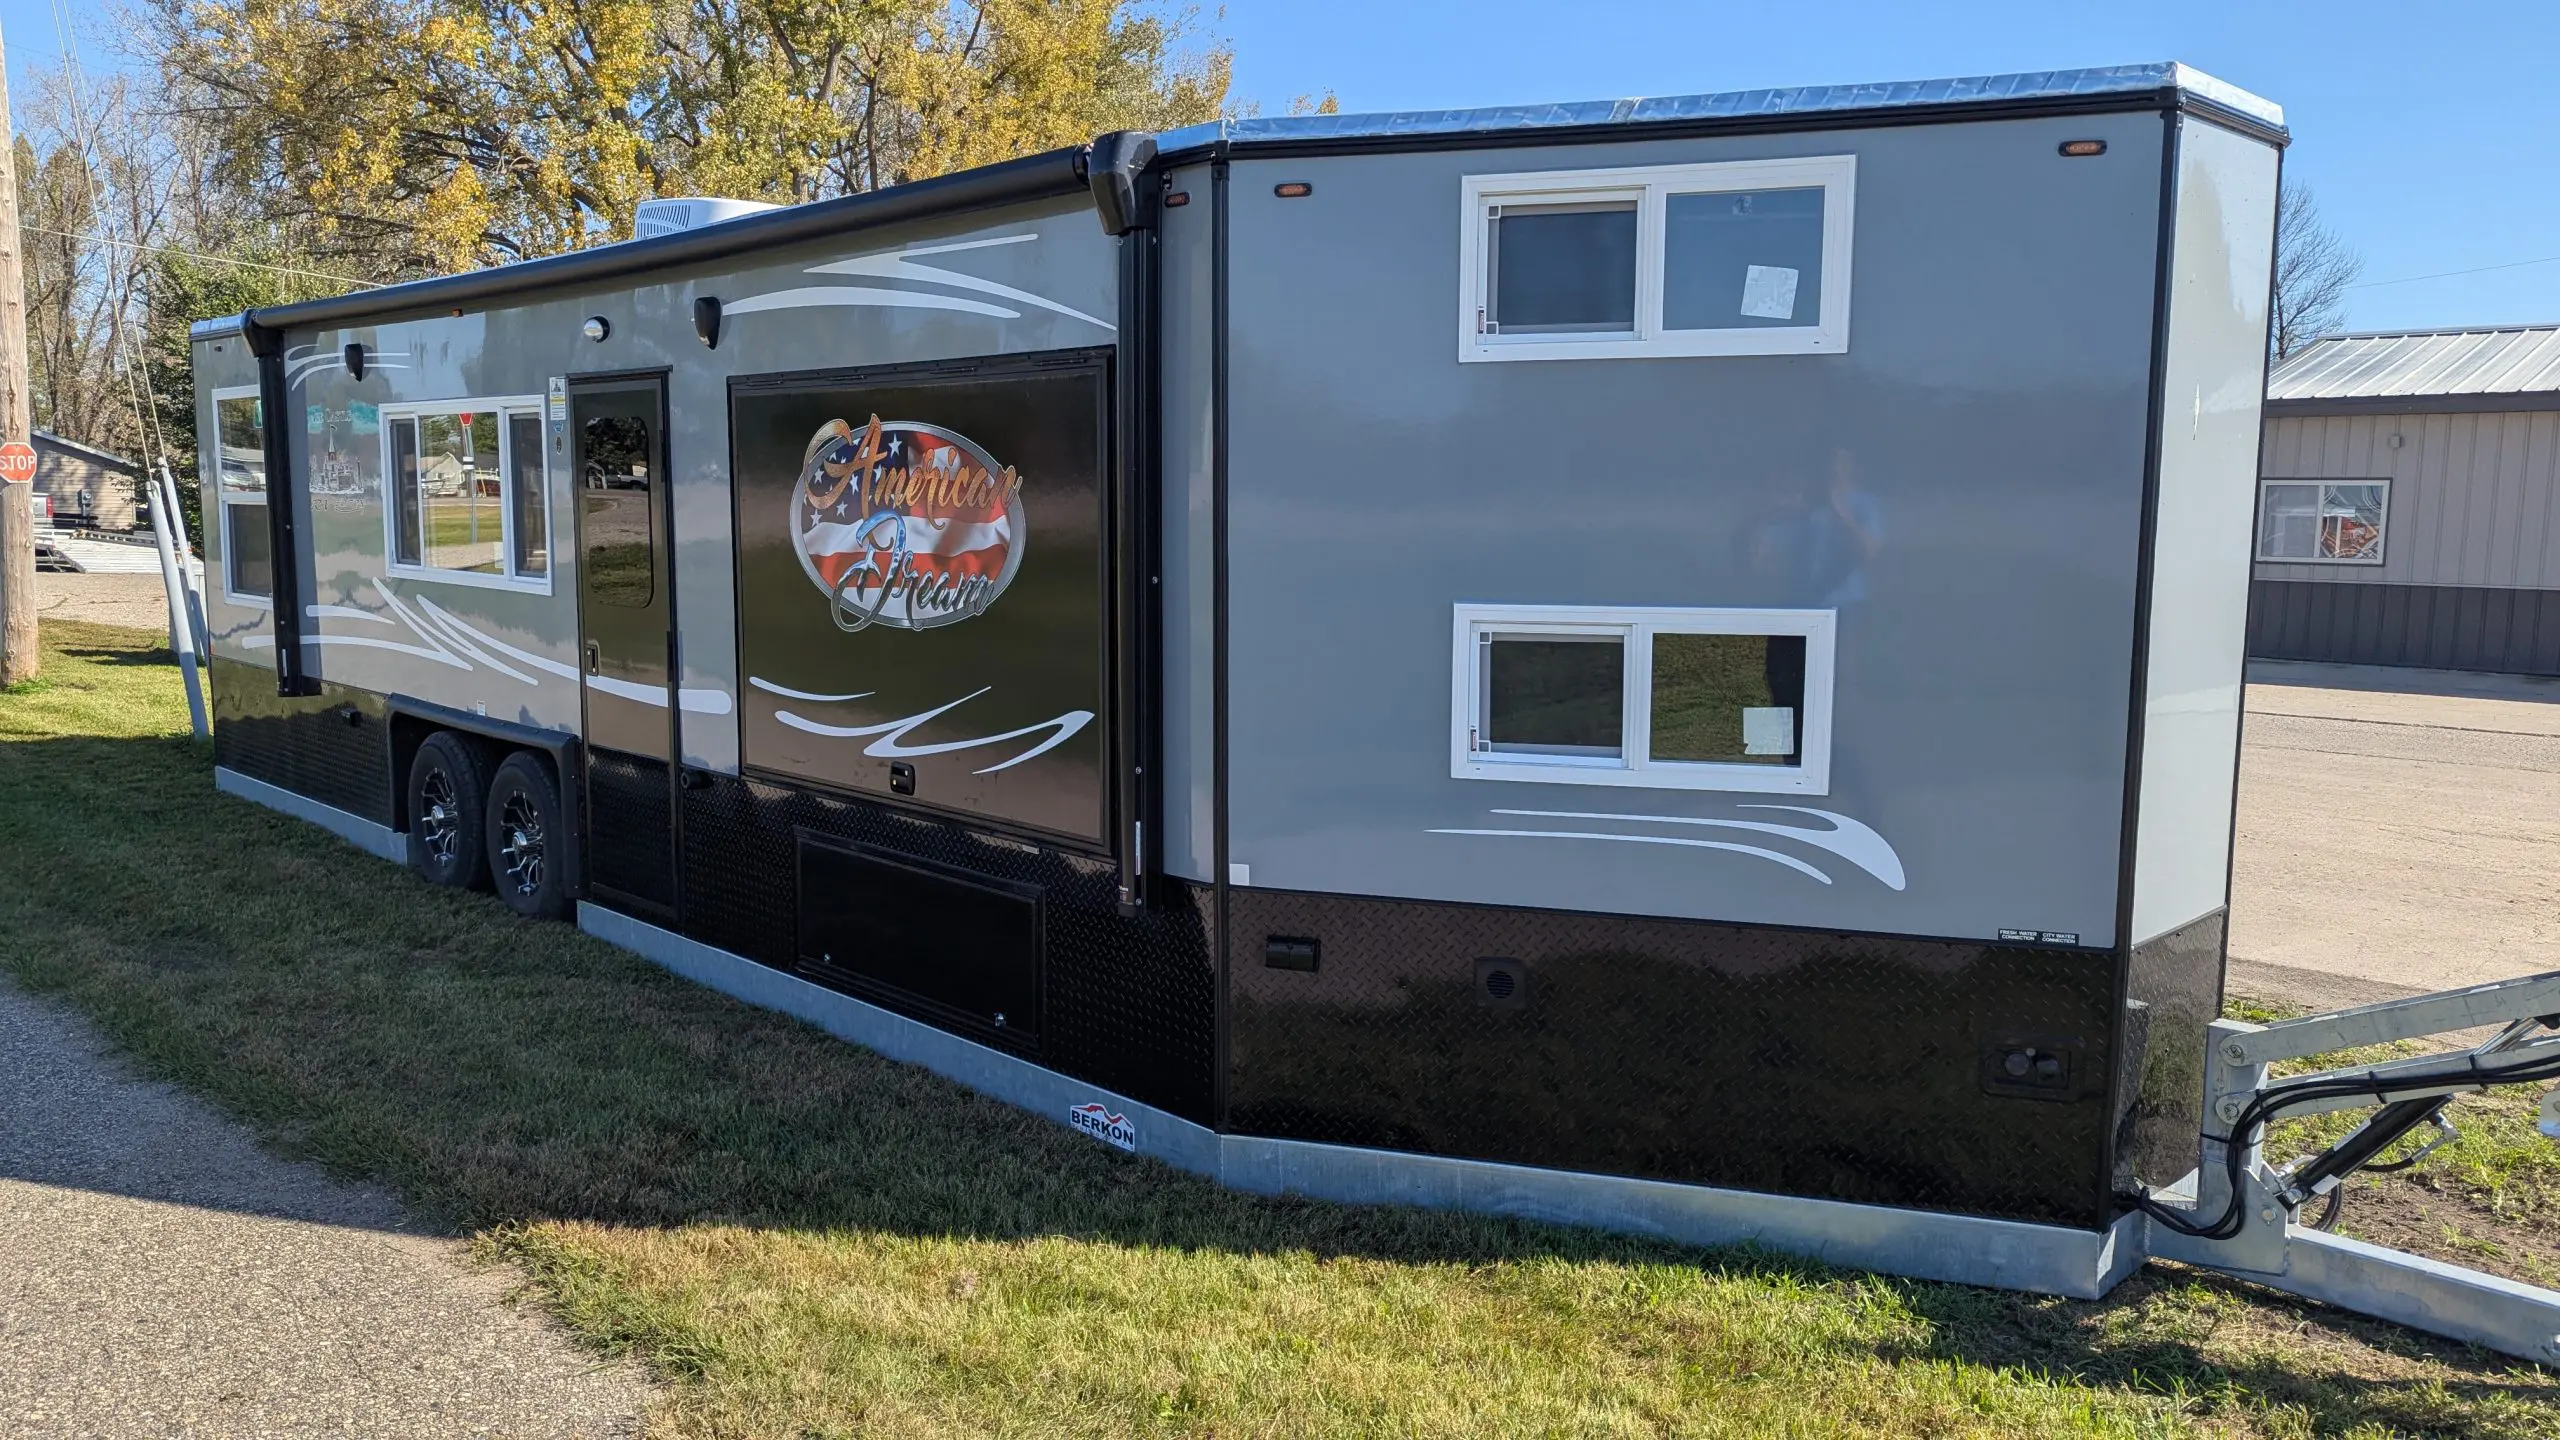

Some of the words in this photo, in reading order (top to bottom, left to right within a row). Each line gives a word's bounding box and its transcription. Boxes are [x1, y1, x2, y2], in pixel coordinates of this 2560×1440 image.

[0, 455, 35, 471] STOP
[804, 413, 1023, 551] American
[831, 511, 996, 633] Dream
[1072, 1110, 1134, 1145] BERKON
